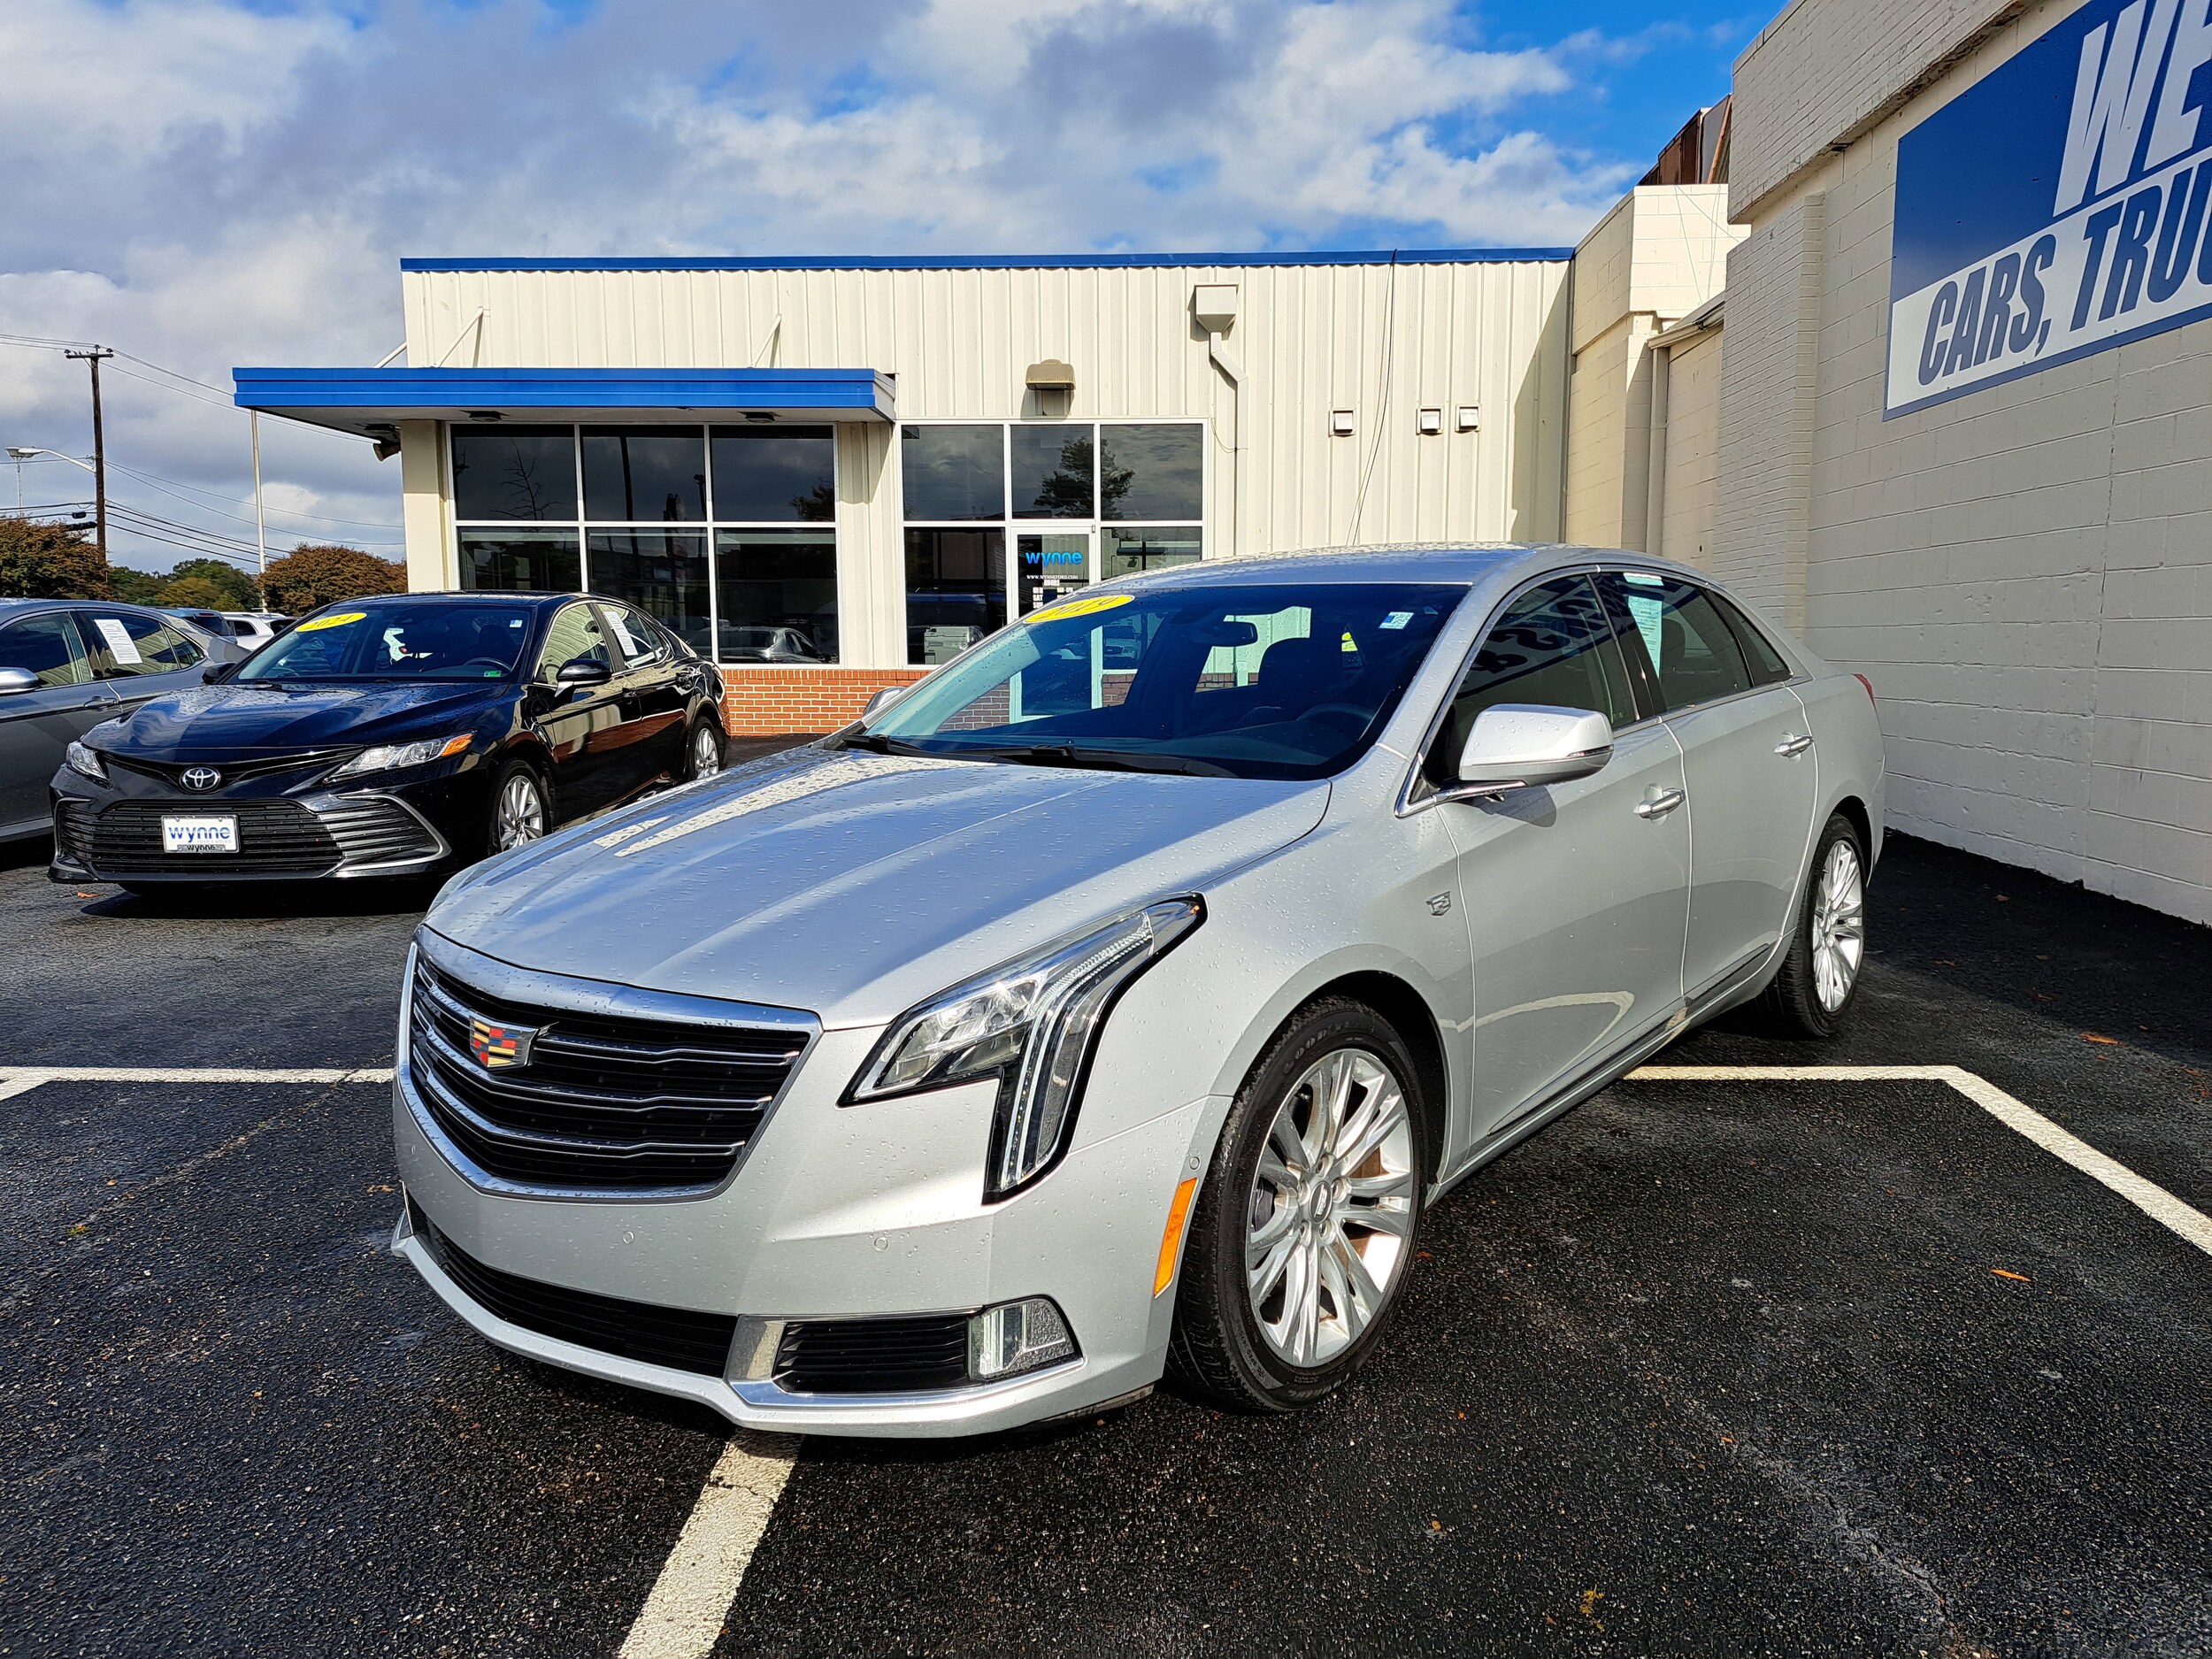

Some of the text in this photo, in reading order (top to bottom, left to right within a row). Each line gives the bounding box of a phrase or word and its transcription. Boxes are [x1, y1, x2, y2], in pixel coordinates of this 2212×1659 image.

[2053, 0, 2212, 217] WE
[1918, 234, 2056, 386] CARS,
[1025, 551, 1083, 567] wynne
[168, 826, 232, 843] wynne
